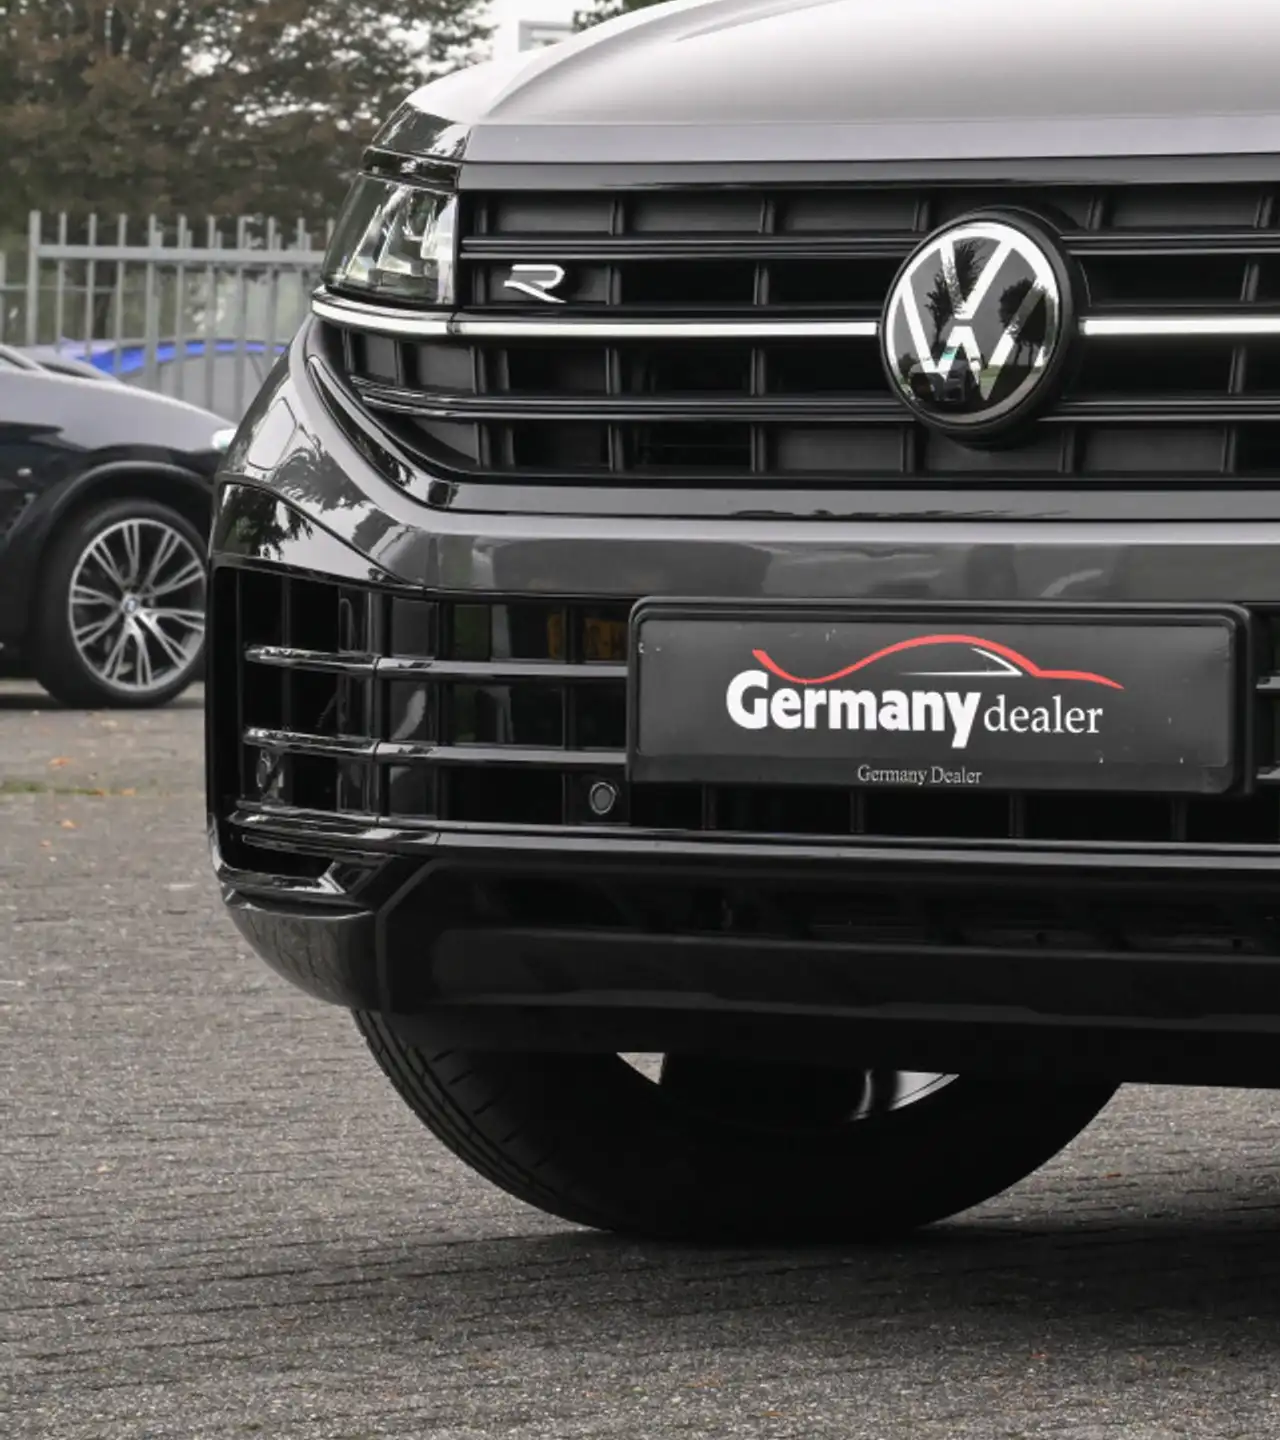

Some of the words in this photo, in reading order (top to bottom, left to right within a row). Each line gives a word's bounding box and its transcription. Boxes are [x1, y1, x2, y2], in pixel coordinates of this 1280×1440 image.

[502, 263, 567, 304] R
[726, 669, 982, 750] Germany
[983, 693, 1104, 735] dealer
[857, 763, 928, 786] Germany
[930, 765, 983, 784] Dealer
